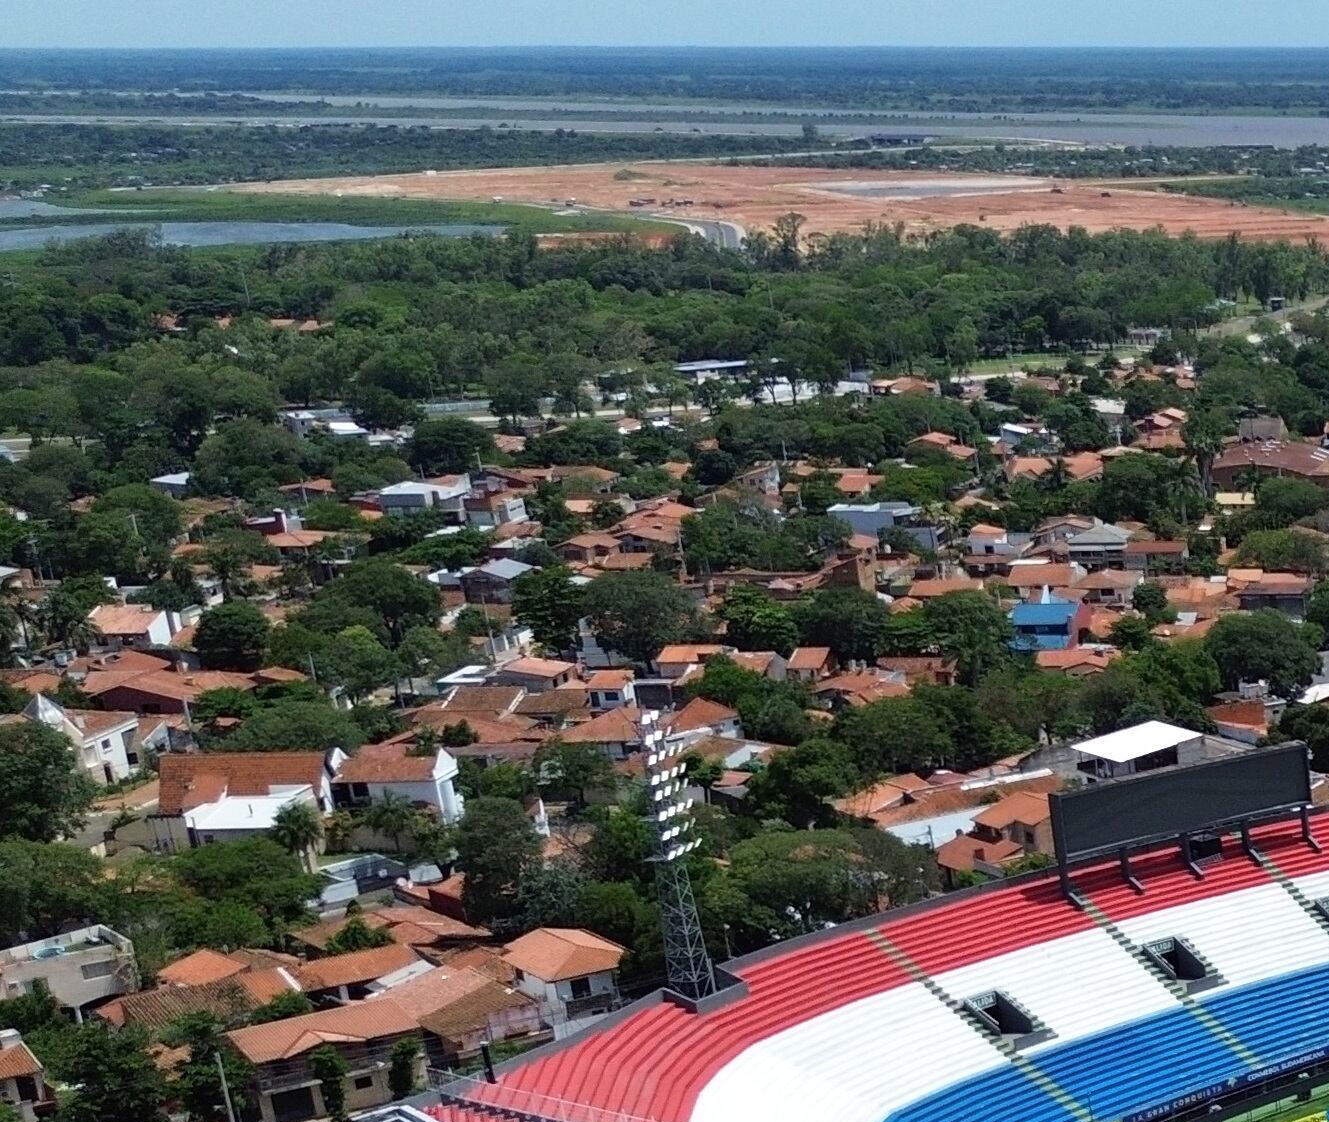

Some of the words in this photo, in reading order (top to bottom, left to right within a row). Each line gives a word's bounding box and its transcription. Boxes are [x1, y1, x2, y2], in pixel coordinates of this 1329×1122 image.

[1247, 1065, 1279, 1081] CONMEBOL
[1281, 1050, 1325, 1070] SUDAMERICANA
[1146, 1104, 1170, 1119] GRAN
[1172, 1085, 1222, 1109] CONQUISTA
